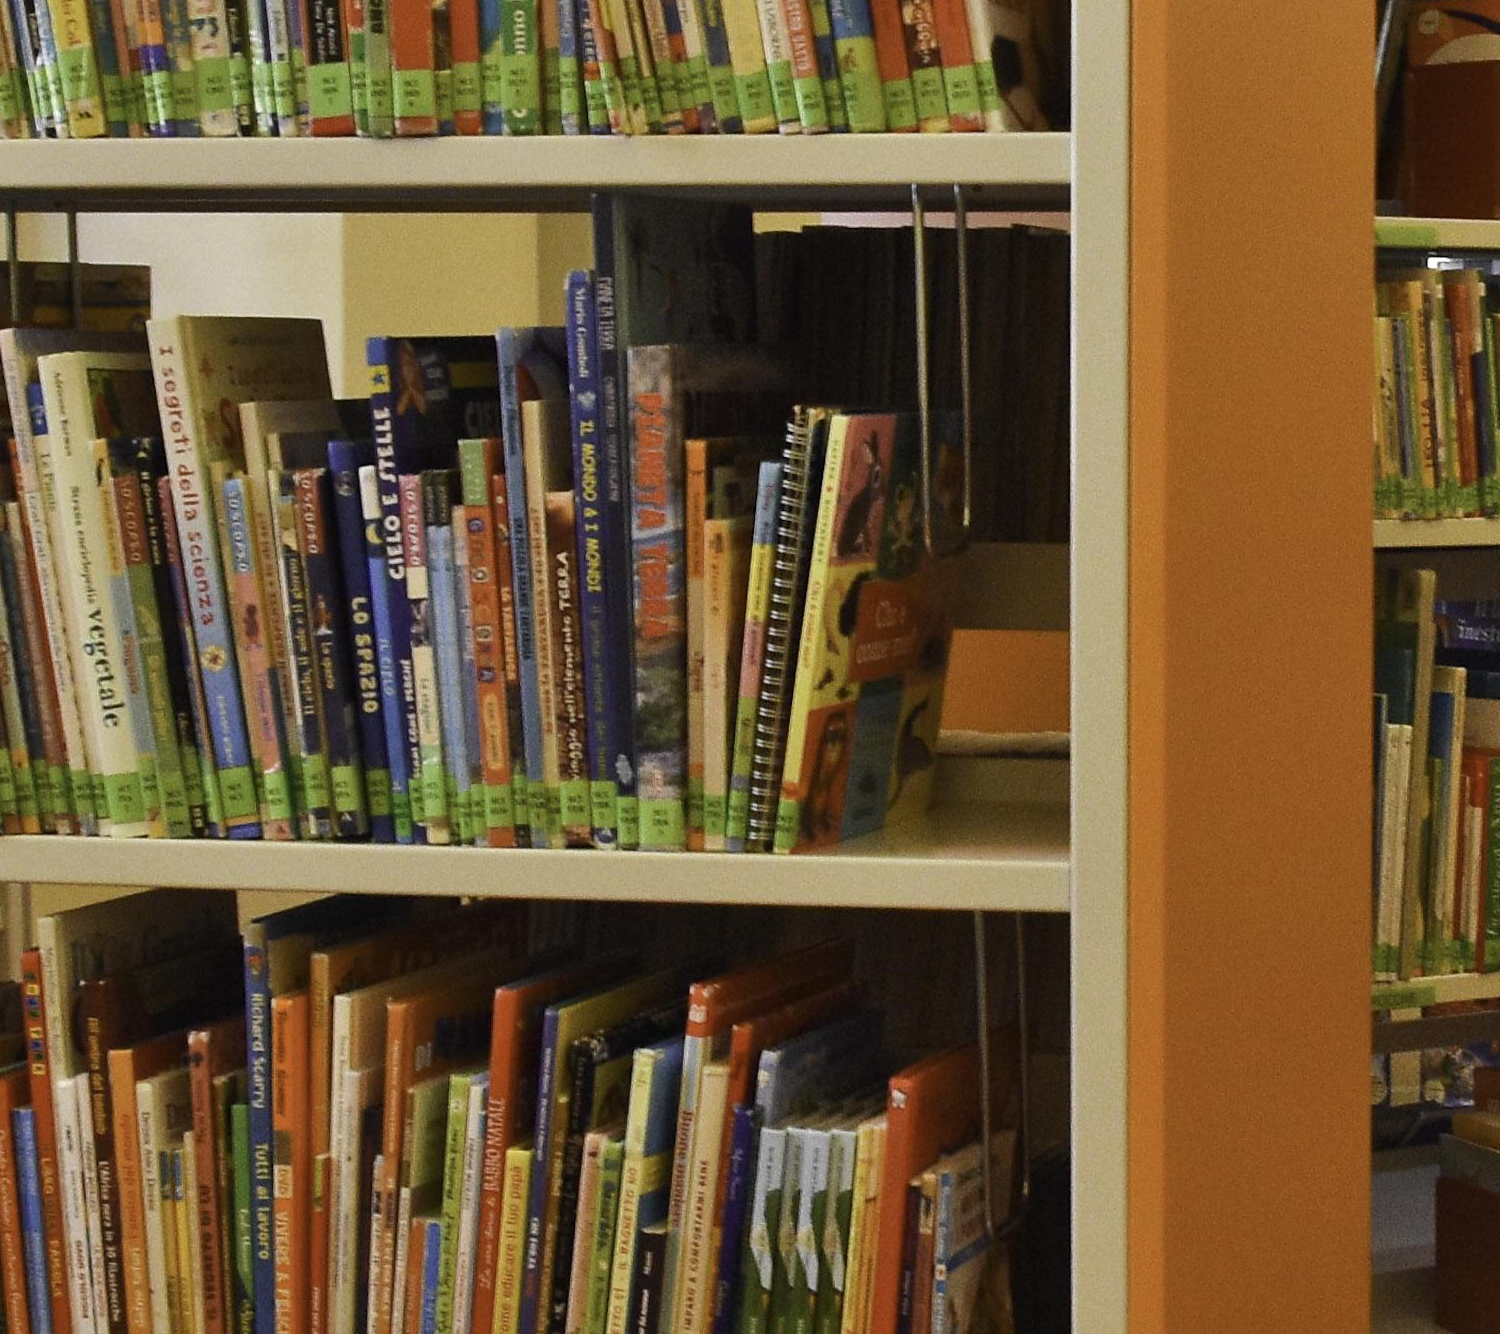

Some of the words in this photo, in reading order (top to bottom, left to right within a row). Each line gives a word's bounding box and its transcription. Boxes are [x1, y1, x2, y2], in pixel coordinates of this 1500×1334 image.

[160, 366, 191, 455] segreti
[372, 407, 396, 484] STELLE
[173, 464, 198, 521] della
[73, 529, 96, 605] enciclopedia
[186, 530, 216, 627] scienza
[386, 520, 404, 580] CIELO
[350, 596, 369, 624] LO
[81, 607, 125, 729] vegetale
[355, 634, 377, 714] SPAZIO
[250, 992, 267, 1051] Richard
[250, 1056, 269, 1108] Scarry
[254, 1142, 270, 1179] Tutti
[256, 1206, 273, 1260] lavoro
